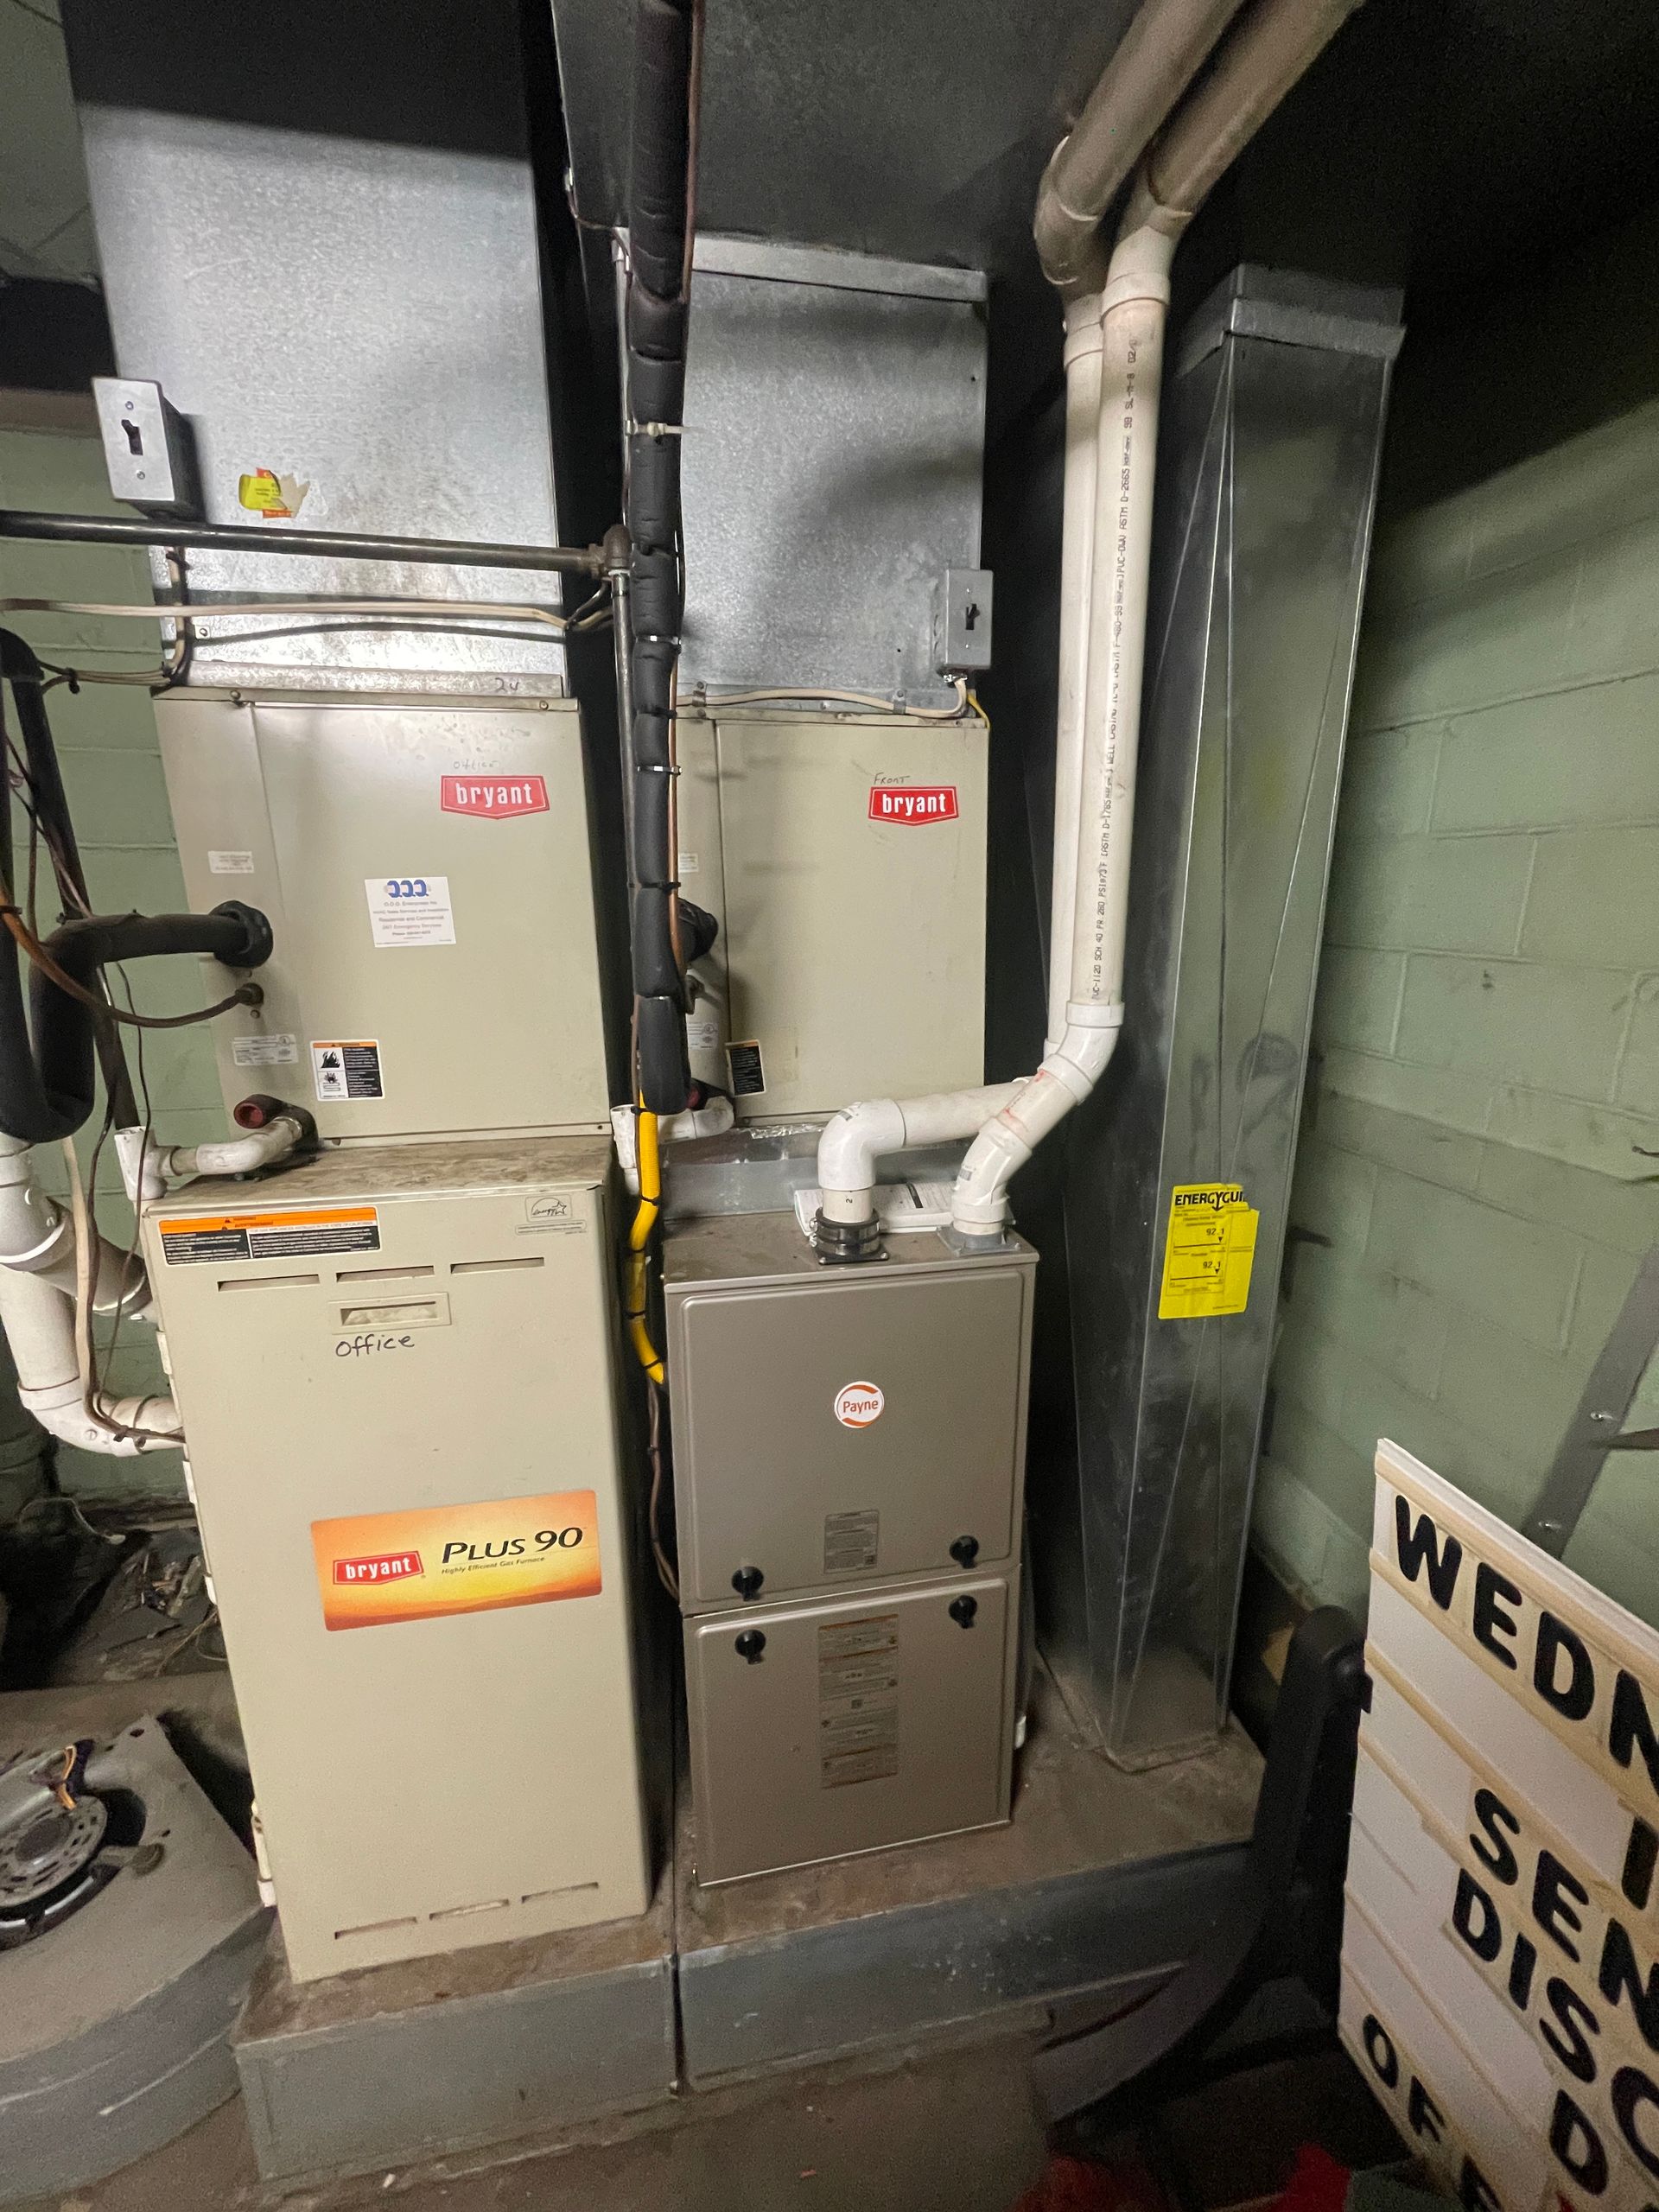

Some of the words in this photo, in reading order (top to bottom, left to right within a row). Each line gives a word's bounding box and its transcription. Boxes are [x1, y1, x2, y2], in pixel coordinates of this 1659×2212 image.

[1119, 506, 1128, 530] ASTM
[455, 782, 533, 809] bryant
[881, 793, 946, 817] bryant
[1174, 1191, 1245, 1209] ENERGYGUI
[842, 1400, 879, 1414] Payne
[534, 1527, 583, 1553] 90
[345, 1557, 412, 1580] bryant
[441, 1566, 467, 1574] Highly
[467, 1562, 498, 1571] Efficient
[516, 1556, 545, 1565] Furnace
[1395, 1495, 1659, 1801] WEDN
